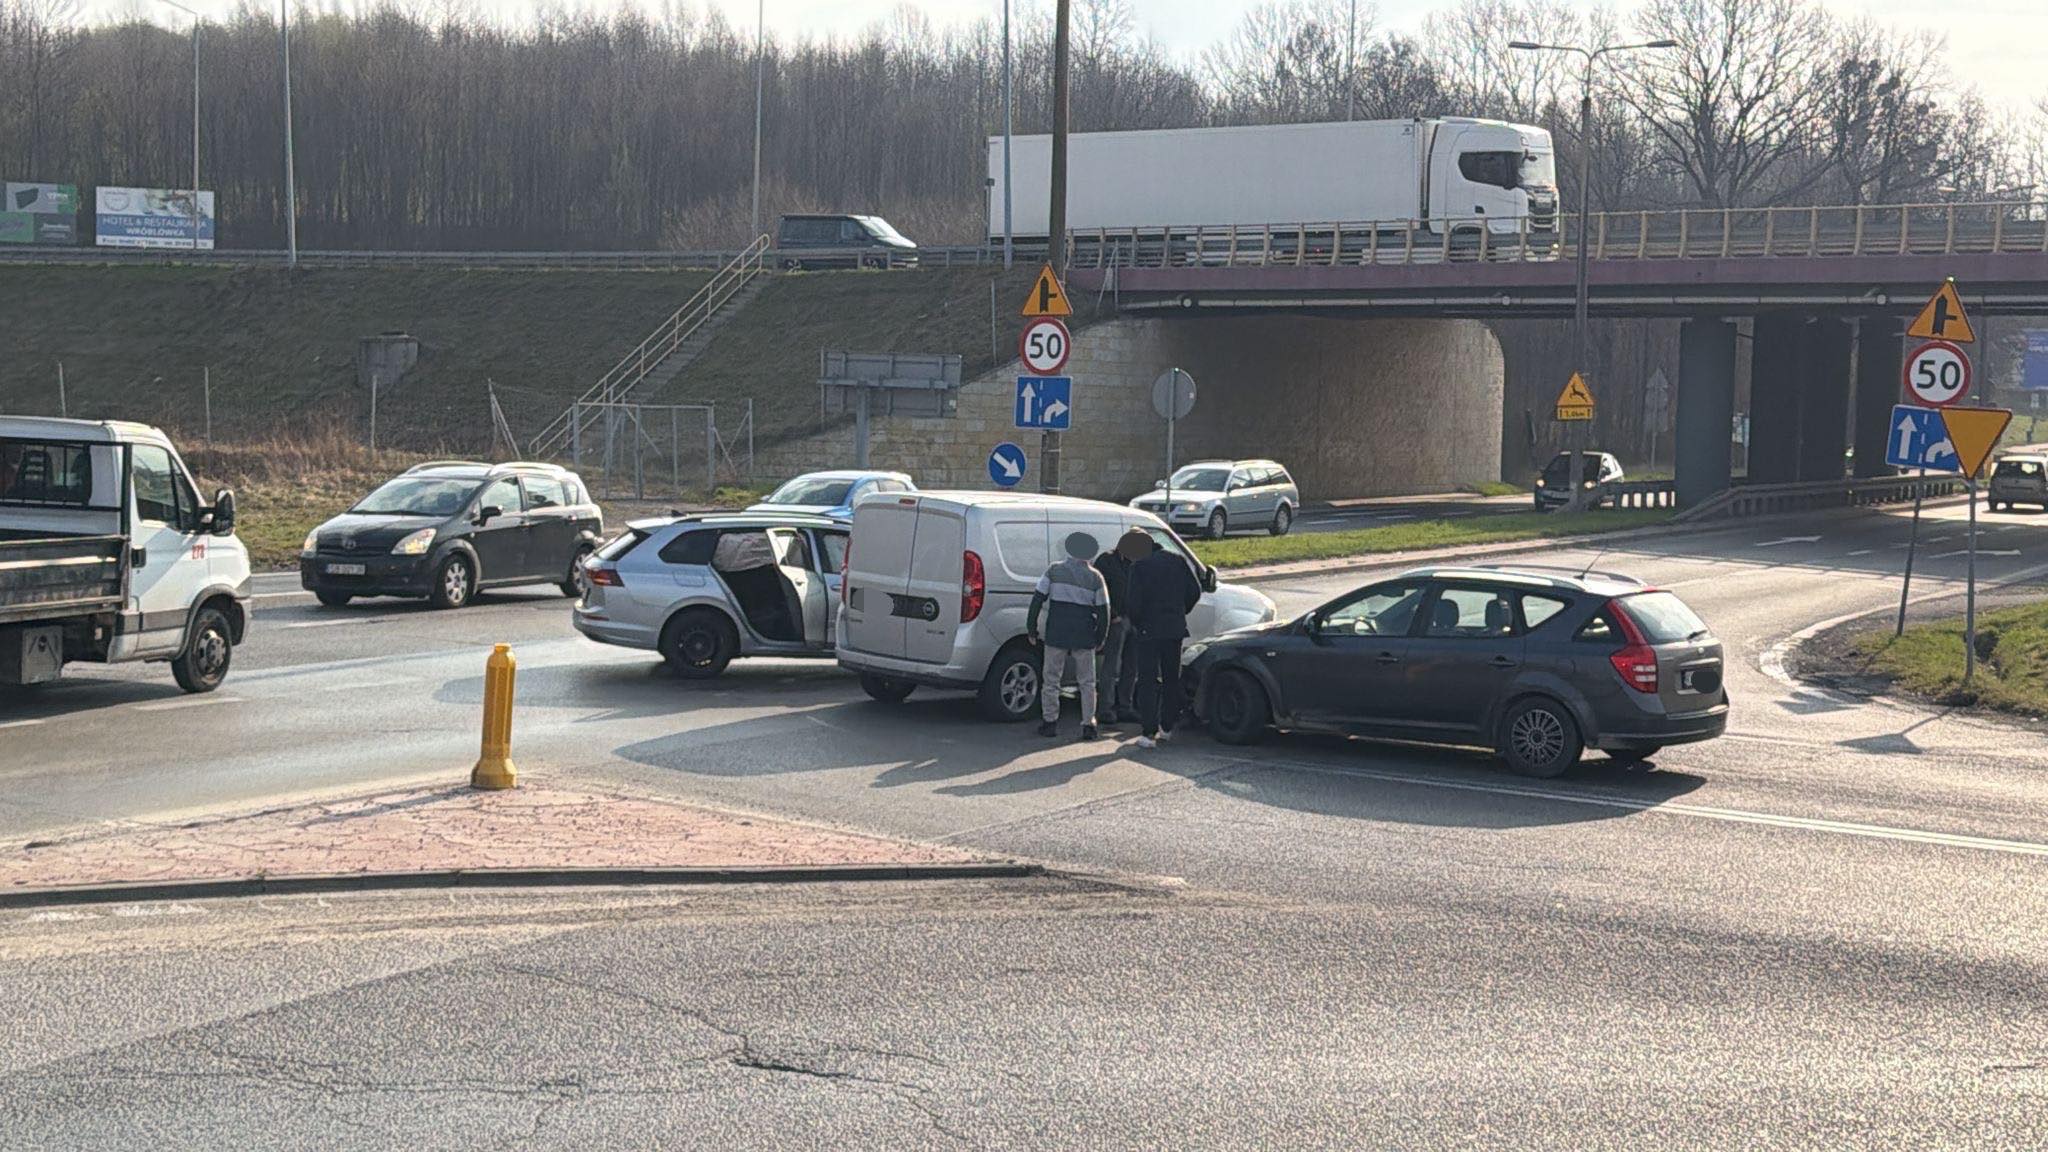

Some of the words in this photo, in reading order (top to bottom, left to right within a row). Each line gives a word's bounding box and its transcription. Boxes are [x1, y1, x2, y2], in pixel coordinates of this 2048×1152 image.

[103, 216, 134, 226] HOTEL
[135, 217, 142, 226] &
[1029, 333, 1062, 359] 50
[1916, 360, 1961, 390] 50
